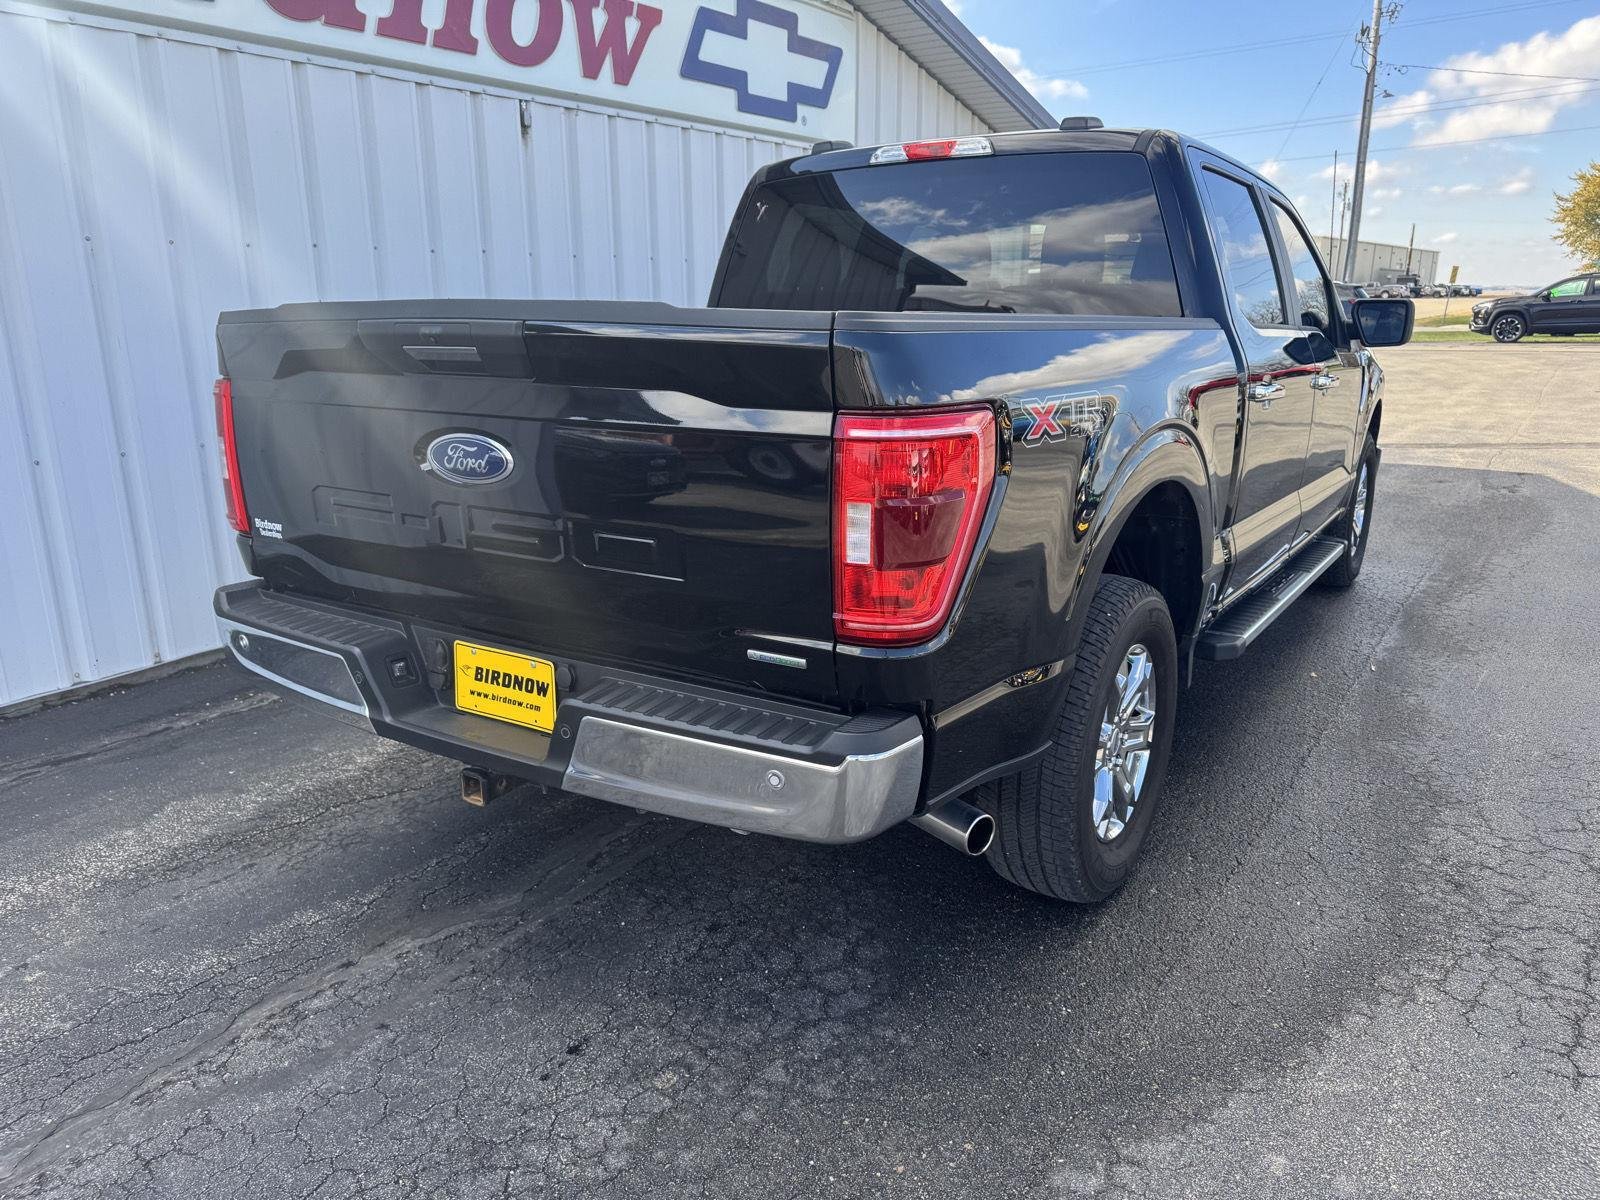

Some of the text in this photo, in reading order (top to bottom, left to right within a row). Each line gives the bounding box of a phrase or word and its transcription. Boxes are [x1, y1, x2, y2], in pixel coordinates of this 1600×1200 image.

[444, 443, 489, 473] Ford
[474, 665, 550, 698] BIRDNOW
[469, 688, 541, 713] www.birdnow.com
